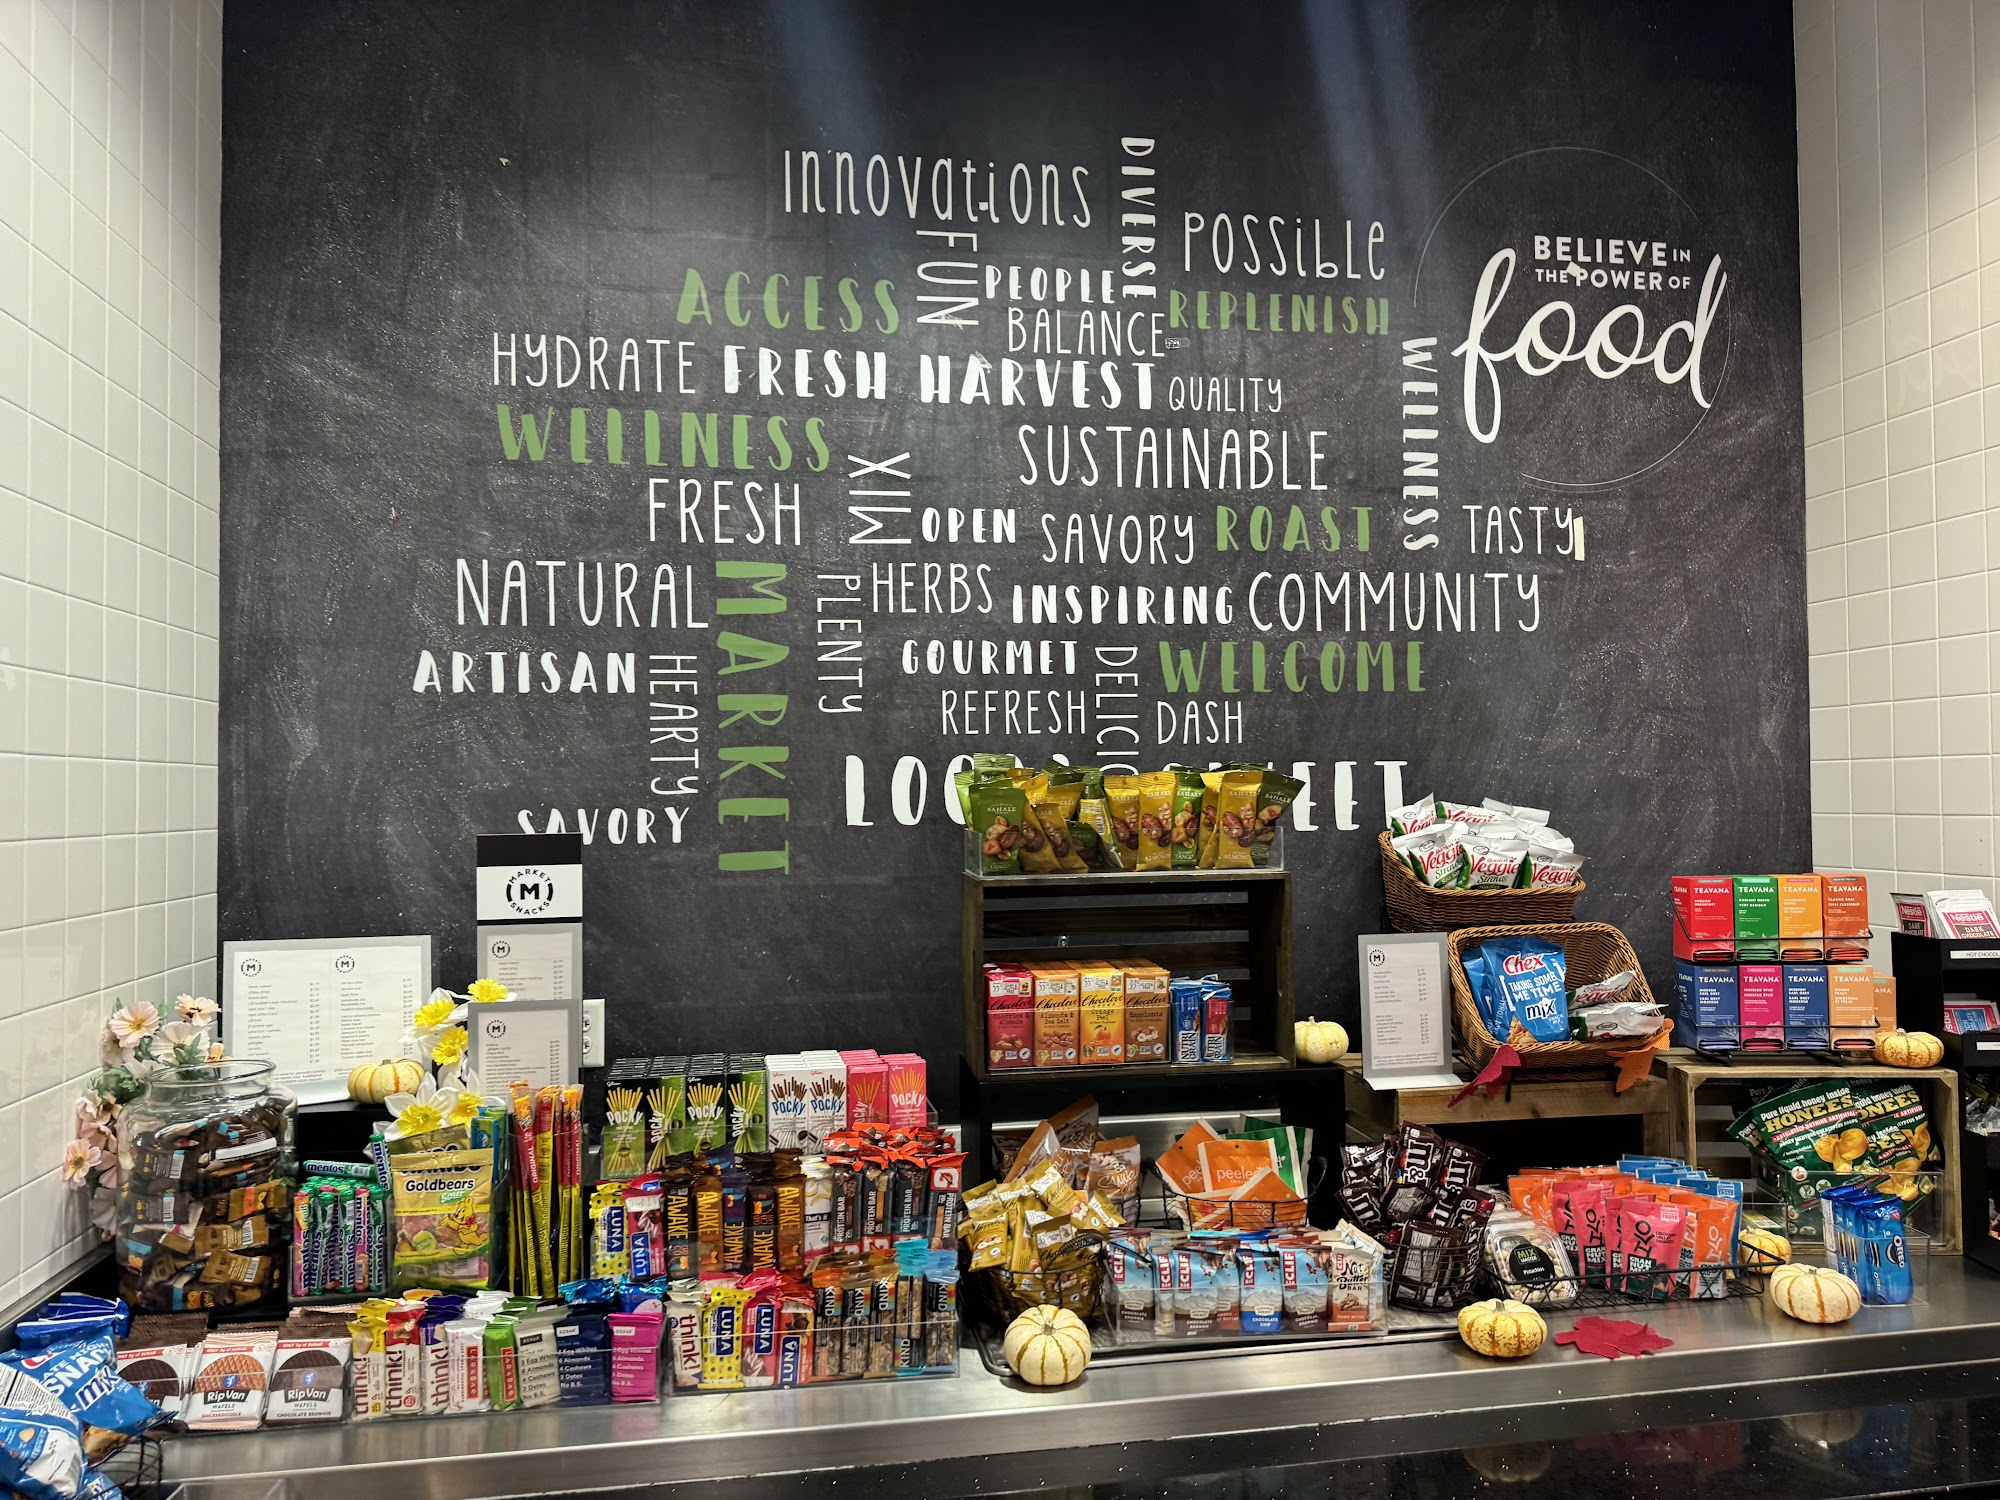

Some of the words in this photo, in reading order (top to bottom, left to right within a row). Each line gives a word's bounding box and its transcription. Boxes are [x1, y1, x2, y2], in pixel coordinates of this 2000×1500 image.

[1121, 137, 1157, 299] DIVERSE
[1534, 235, 1667, 267] BELIEVE
[1672, 249, 1691, 262] IN
[917, 230, 979, 327] FUN
[986, 265, 1115, 303] PEOPLE
[1535, 269, 1568, 283] THE
[1576, 269, 1663, 291] POWER
[1668, 276, 1691, 290] OF
[677, 268, 899, 334] ACCESS
[1170, 290, 1389, 335] REPLENISH
[1008, 308, 1165, 357] BALANCE
[1451, 248, 1727, 443] food
[494, 333, 696, 394] HYDRATE
[724, 345, 886, 399] FRESH
[920, 355, 1155, 409] HARVEST
[1169, 376, 1283, 413] QUALITY
[496, 404, 830, 472] WELLNESS
[1402, 337, 1439, 550] WELLNESS
[1018, 424, 1328, 490] SUSTAINABLE
[648, 478, 801, 545] FRESH
[847, 452, 912, 545] MIX
[922, 508, 1016, 543] OPEN
[1041, 513, 1196, 566] SAVORY
[1217, 505, 1373, 552] ROAST
[1462, 505, 1576, 555] TASTY
[456, 559, 709, 628] NATURAL
[872, 561, 993, 615] HERBS
[1012, 585, 1233, 625] INSPIRING
[1248, 571, 1541, 632] COMMUNITY
[817, 574, 863, 715] PLENTY
[902, 639, 1077, 676] GOURMET
[413, 650, 635, 693] ARTISAN
[1159, 640, 1426, 693] WELCOME
[649, 654, 699, 796] HEARTY
[715, 561, 790, 876] MARKET
[941, 689, 1087, 735] REFRESH
[1157, 701, 1244, 745] DASH
[517, 807, 690, 845] SAVORY
[508, 868, 551, 884] MARKET
[1470, 855, 1519, 876] Veggie
[510, 901, 550, 916] SNACKS
[520, 883, 540, 900] M
[1505, 953, 1545, 975] Chex
[1508, 979, 1534, 992] TAKING
[1535, 971, 1557, 985] SOME
[1513, 991, 1529, 1003] ME
[1529, 981, 1562, 997] TIME
[1036, 998, 1078, 1011] Chocolove
[1082, 995, 1123, 1008] Chocolove
[1091, 1009, 1115, 1017] Orange
[1127, 996, 1166, 1007] Chocolove
[1527, 999, 1555, 1020] mix
[687, 1103, 724, 1121] Pocky
[771, 1097, 806, 1115] Pocky
[810, 1096, 844, 1113] Pocky
[891, 1090, 924, 1107] Pocky
[1761, 1111, 1778, 1121] Pure
[1778, 1102, 1801, 1114] liquid
[1800, 1094, 1826, 1107] honey
[1827, 1087, 1850, 1098] inside
[1765, 1094, 1853, 1133] HONEES
[606, 1108, 643, 1126] Pocky
[649, 1110, 666, 1143] Pocky
[730, 1105, 746, 1138] Pocky
[1738, 1122, 1756, 1138] Pure
[307, 1163, 344, 1174] mentos
[373, 1142, 389, 1190] mentos
[527, 1145, 538, 1184] ORIGINAL
[405, 1178, 475, 1193] Goldbears
[441, 1190, 465, 1203] Sour
[868, 1191, 876, 1208] BAR
[904, 1188, 912, 1207] BAR
[667, 1195, 688, 1241] AWAKE
[698, 1192, 719, 1235] AWAKE
[779, 1187, 800, 1230] AWAKE
[837, 1196, 845, 1214] BAR
[867, 1209, 876, 1235] PROTEIN
[903, 1207, 912, 1233] PROTEIN
[945, 1192, 955, 1220] PROTEIN
[611, 1209, 622, 1249] LUNA
[724, 1221, 744, 1264] AWAKE
[836, 1215, 845, 1242] PROTEIN
[310, 1231, 322, 1288] mentos
[636, 1236, 647, 1276] LUNA
[1114, 1248, 1125, 1273] CLIF
[1180, 1255, 1190, 1283] CLIF
[1244, 1256, 1254, 1279] CLIF
[1285, 1253, 1295, 1280] CLIF
[1336, 1254, 1344, 1269] CLIF
[1341, 1260, 1364, 1276] Nut
[1517, 1248, 1536, 1259] MIX
[1629, 1256, 1652, 1266] CRAN
[1630, 1262, 1652, 1271] NUT
[1893, 1235, 1905, 1269] OREO
[1159, 1256, 1171, 1283] CLIF
[1337, 1275, 1368, 1290] Butter
[1523, 1266, 1545, 1275] Pistachios
[825, 1286, 835, 1317] KIND
[854, 1288, 864, 1316] KIND
[879, 1281, 889, 1311] KIND
[938, 1283, 948, 1311] KIND
[680, 1313, 701, 1370] think!
[721, 1310, 732, 1351] LUNA
[759, 1308, 772, 1350] LUNA
[783, 1341, 796, 1382] LUNA
[901, 1338, 910, 1367] KIND
[81, 1371, 119, 1406] mix
[354, 1356, 369, 1415] think!
[386, 1350, 403, 1410] think!
[430, 1346, 449, 1407] think!
